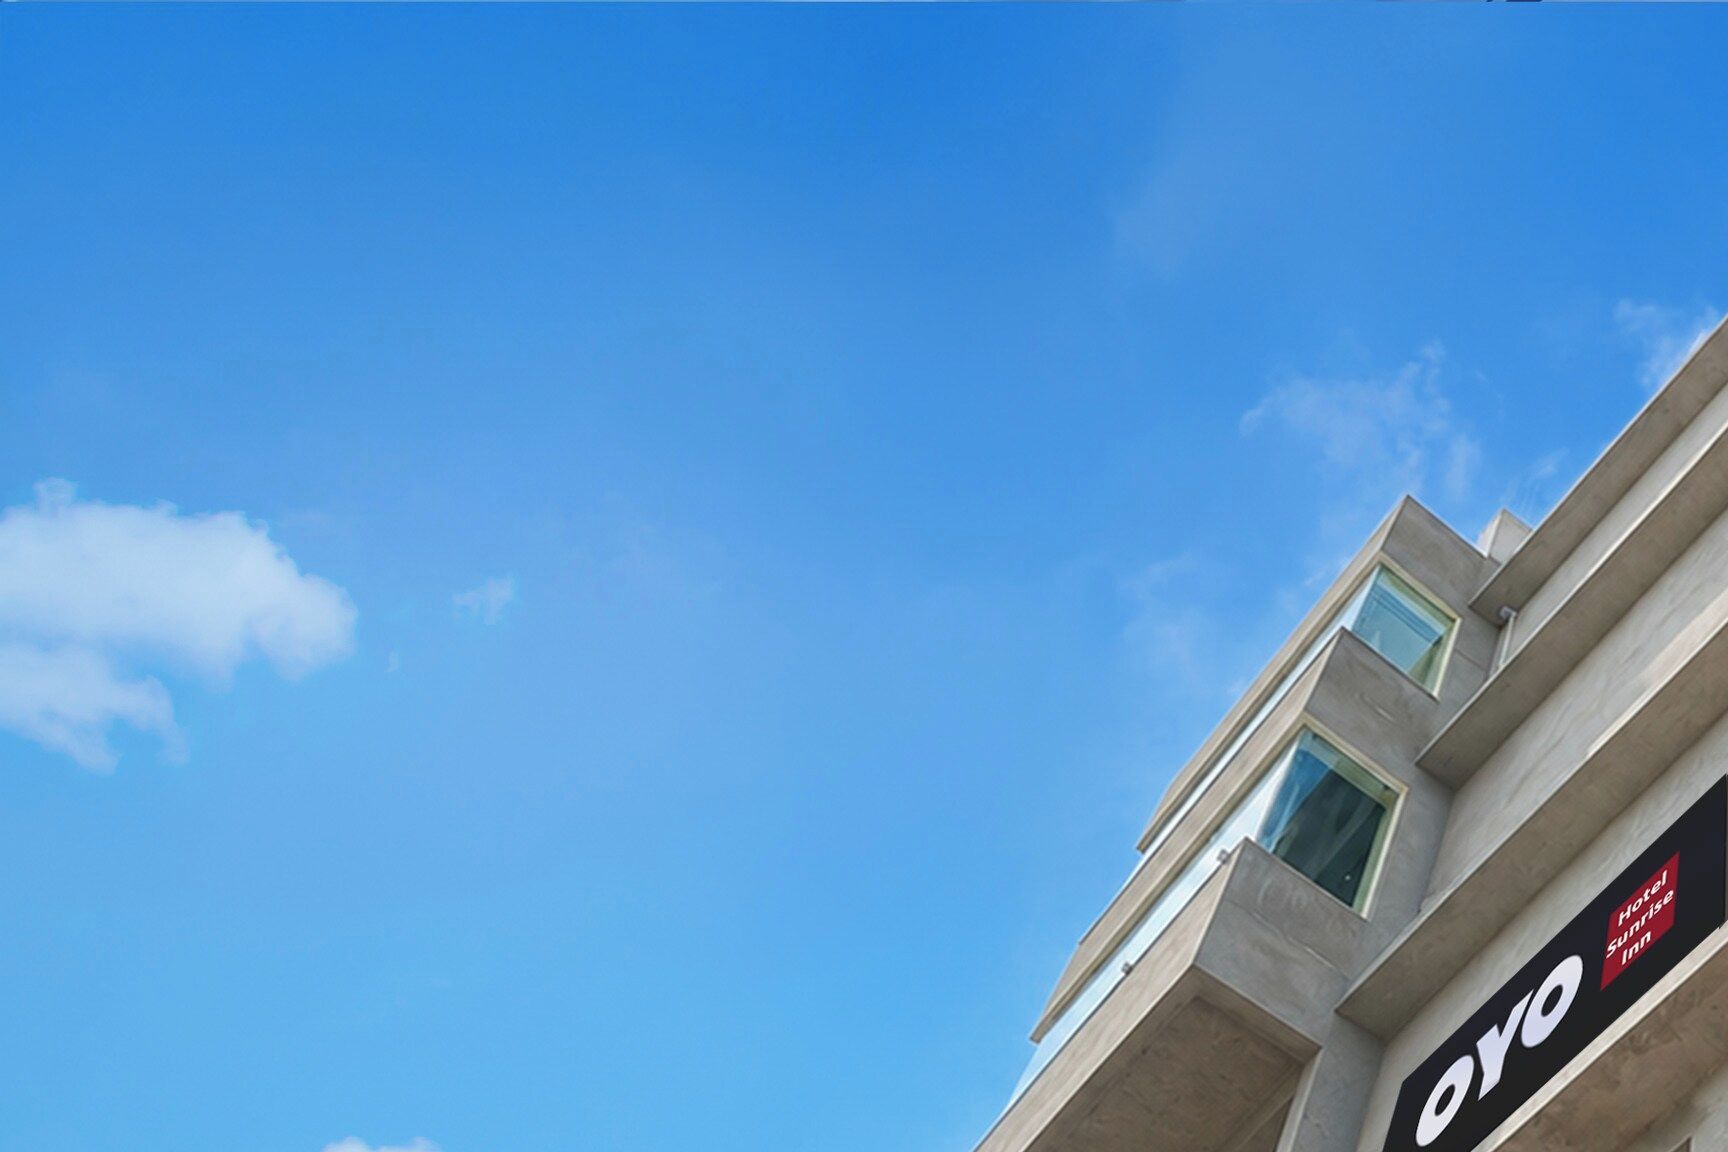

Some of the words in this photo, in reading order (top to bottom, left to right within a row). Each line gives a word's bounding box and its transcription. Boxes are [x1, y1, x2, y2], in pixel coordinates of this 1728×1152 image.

[1606, 890, 1674, 959] Sunrise
[1618, 869, 1667, 927] Hotel
[1621, 931, 1651, 966] Inn
[1415, 954, 1584, 1147] OYO
